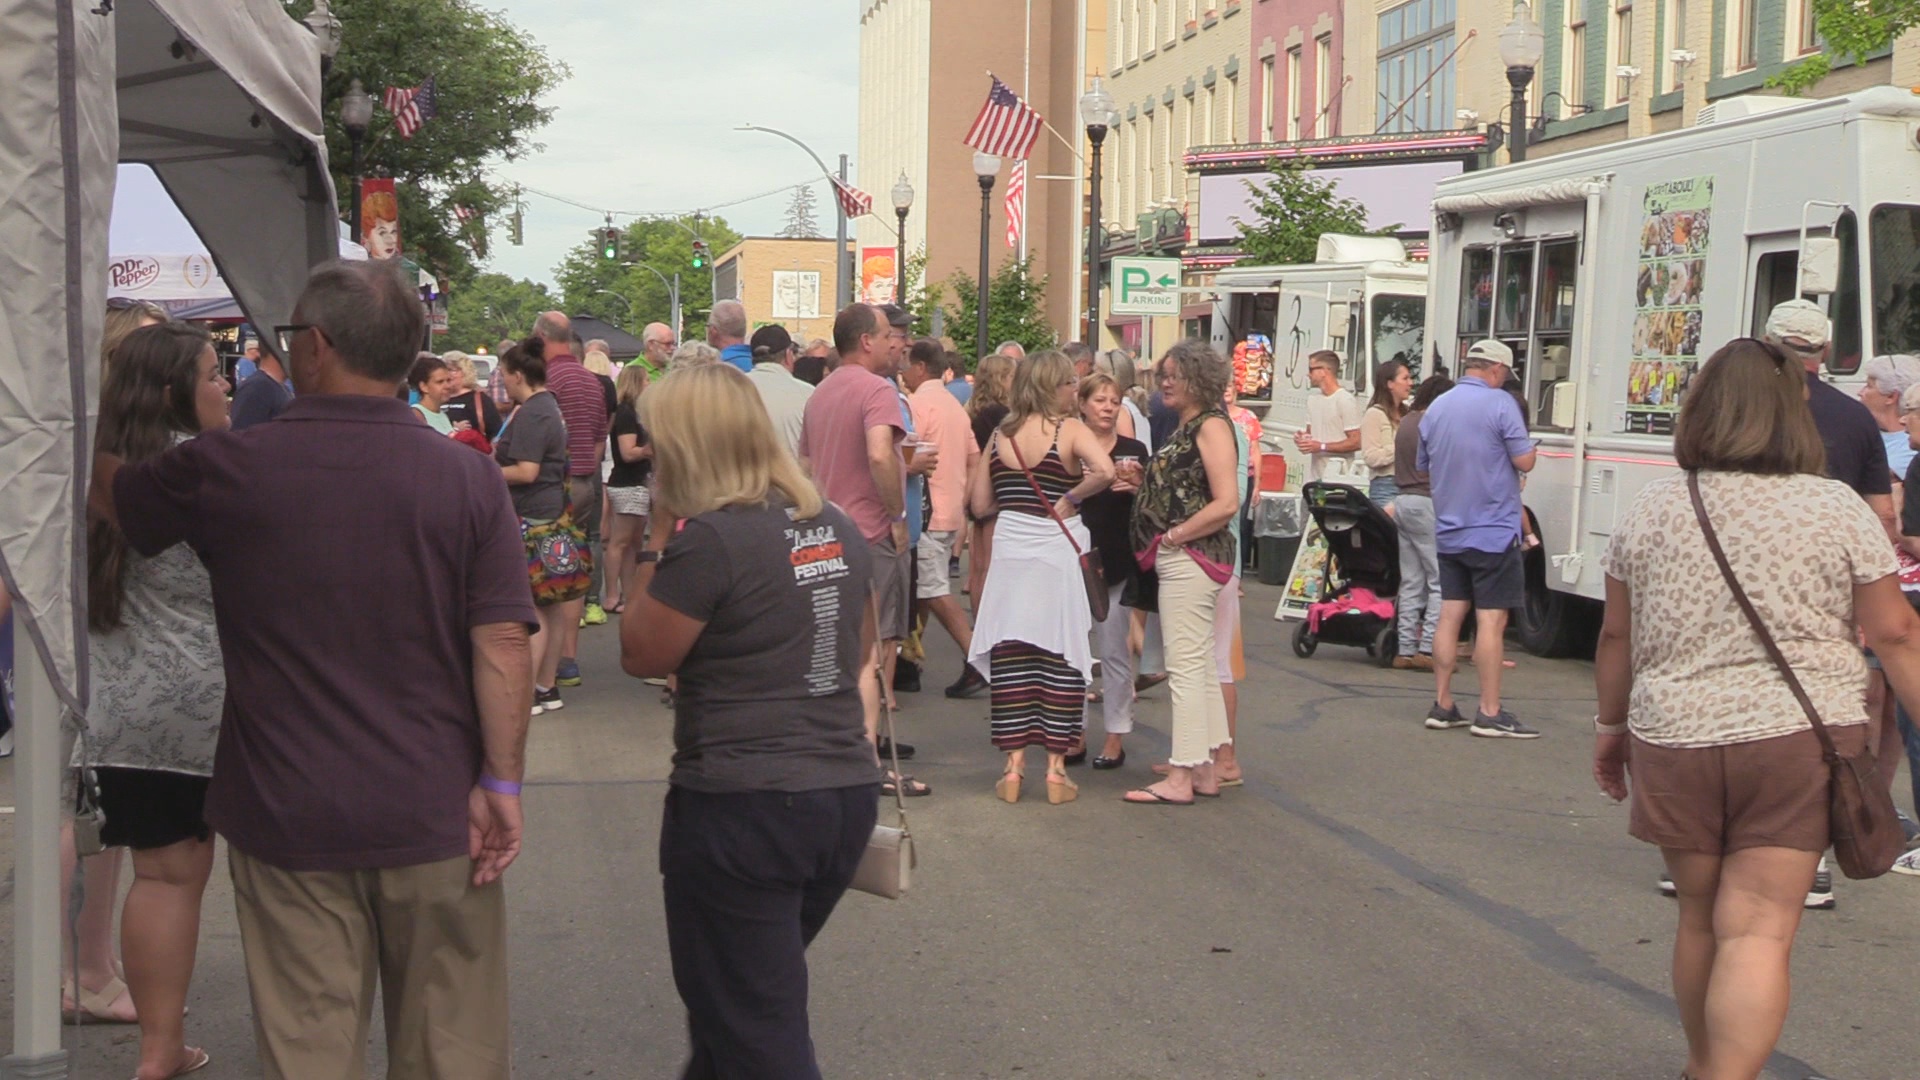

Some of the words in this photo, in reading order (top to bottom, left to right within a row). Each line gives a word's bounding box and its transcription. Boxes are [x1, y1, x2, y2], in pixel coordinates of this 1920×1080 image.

[109, 262, 156, 288] Pepper
[124, 259, 143, 273] Dr
[789, 542, 845, 567] COMEDY
[793, 557, 849, 580] FESTIVAL
